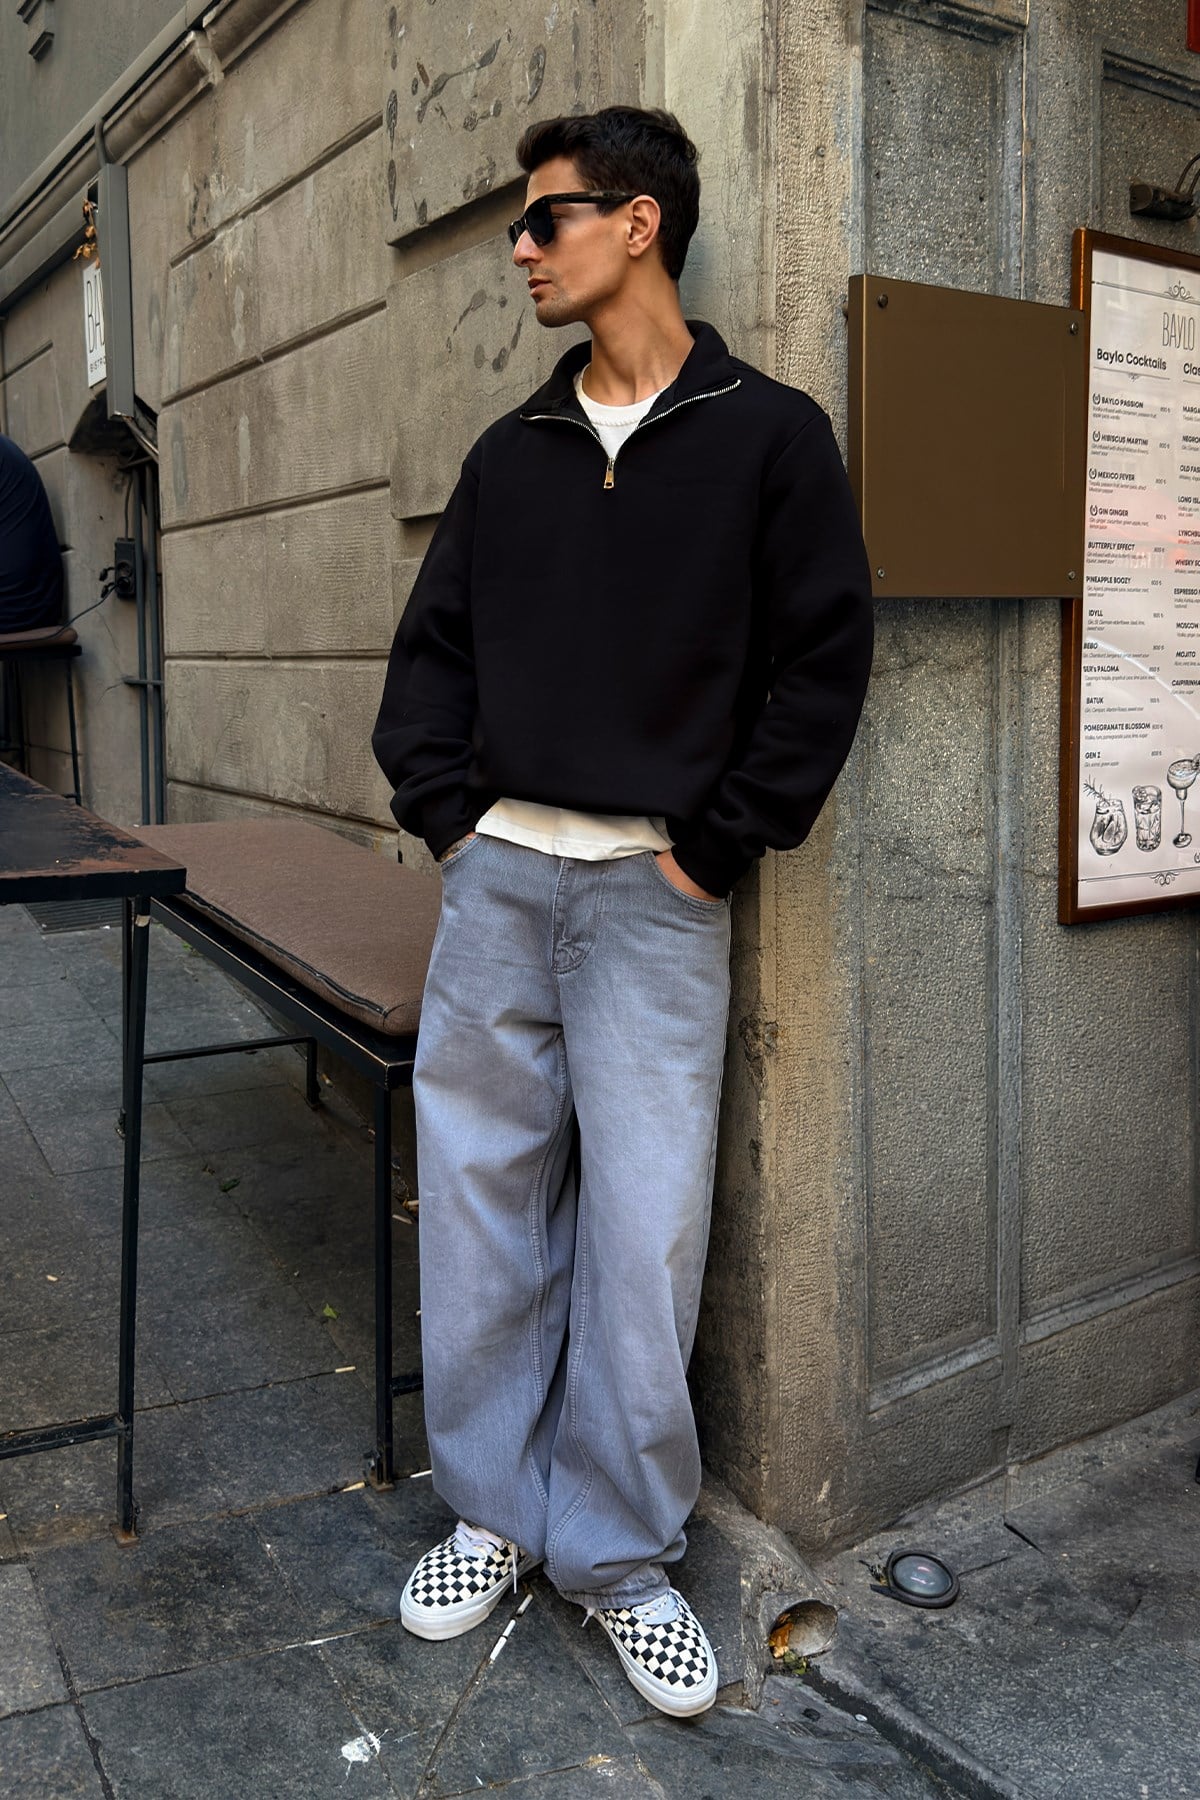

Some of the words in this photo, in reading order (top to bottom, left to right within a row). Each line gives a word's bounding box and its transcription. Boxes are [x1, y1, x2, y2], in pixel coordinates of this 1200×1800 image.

[87, 269, 104, 353] BA
[1162, 312, 1194, 350] BAYLO
[1096, 348, 1124, 364] Baylo
[1126, 352, 1167, 370] Cocktails
[1102, 396, 1120, 406] BAYLO
[1120, 400, 1143, 408] PASSION
[1102, 434, 1126, 443] HIBISCUS
[1127, 437, 1148, 445] MARTINI
